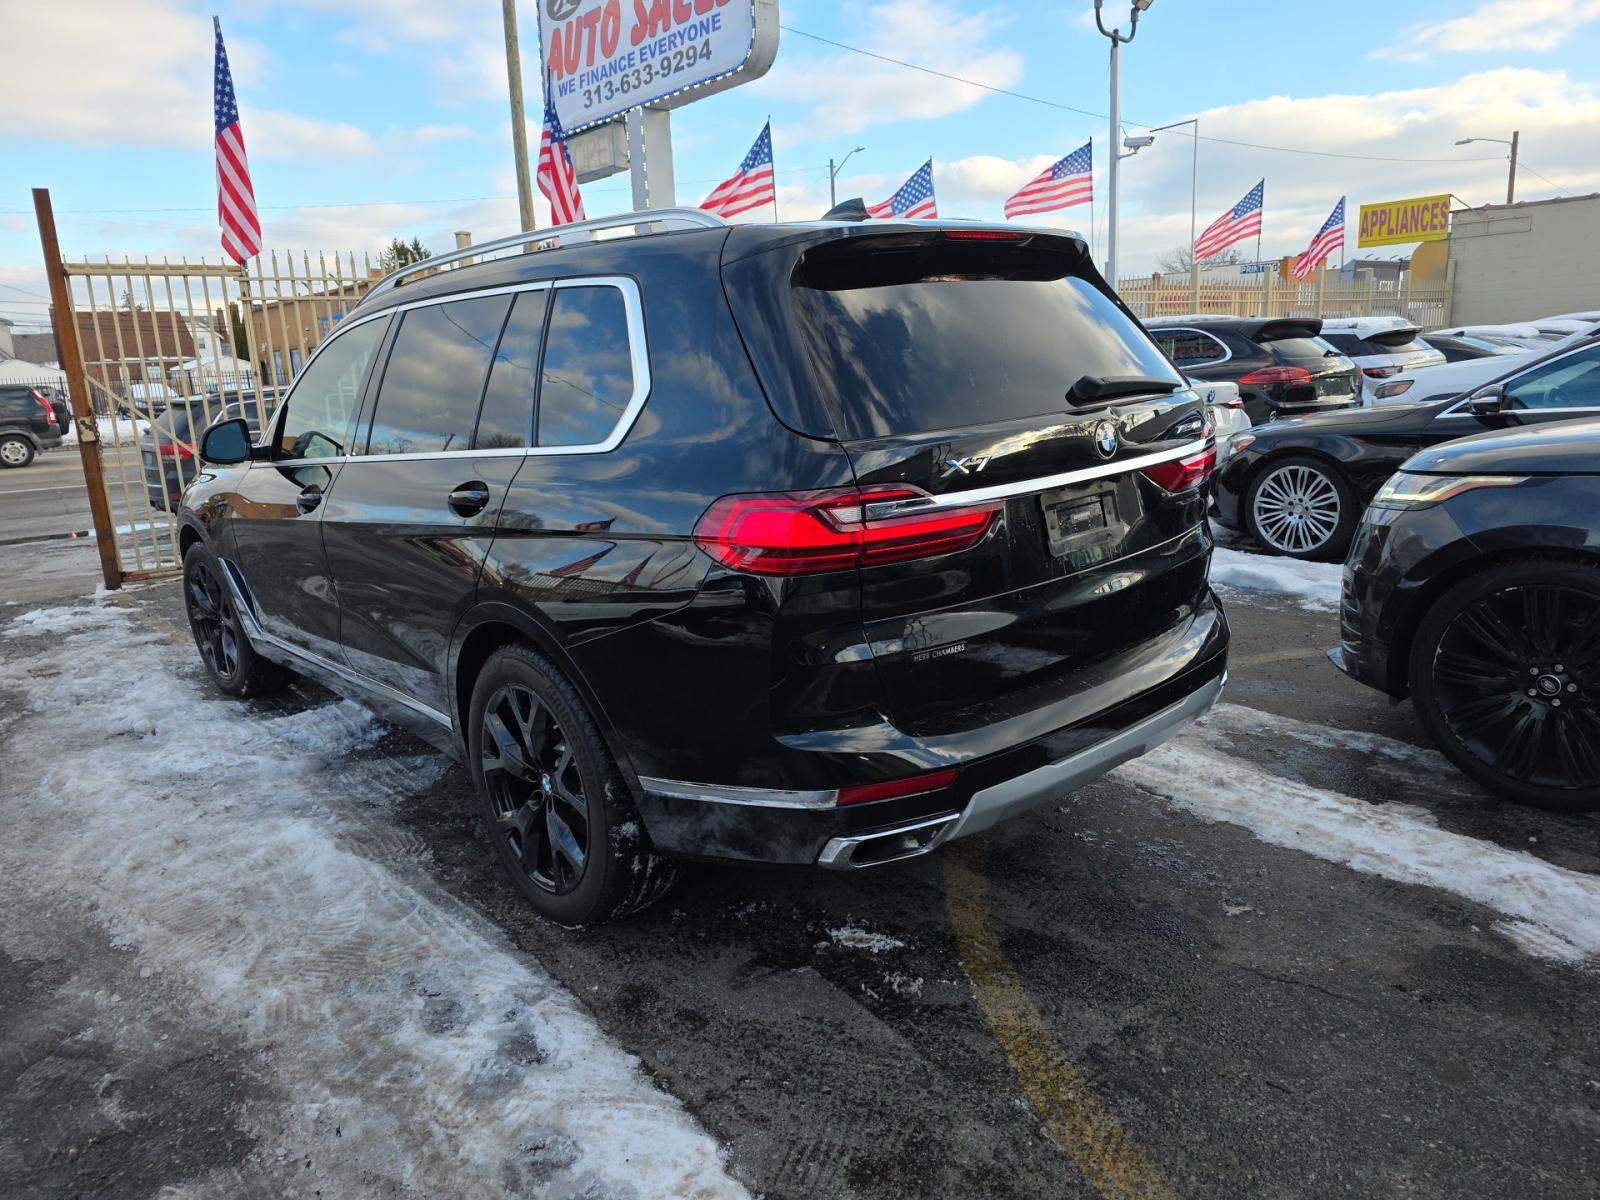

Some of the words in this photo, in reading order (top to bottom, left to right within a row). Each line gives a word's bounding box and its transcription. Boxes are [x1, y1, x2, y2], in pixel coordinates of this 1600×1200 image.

[547, 0, 621, 81] AUTO
[558, 77, 576, 98] WE
[579, 52, 635, 87] FINANCE
[639, 13, 722, 63] EVERYONE
[583, 38, 713, 109] 313-633-9294
[1360, 201, 1449, 239] APPLIANCES
[940, 456, 992, 478] X7
[932, 644, 965, 658] CHAMBERS
